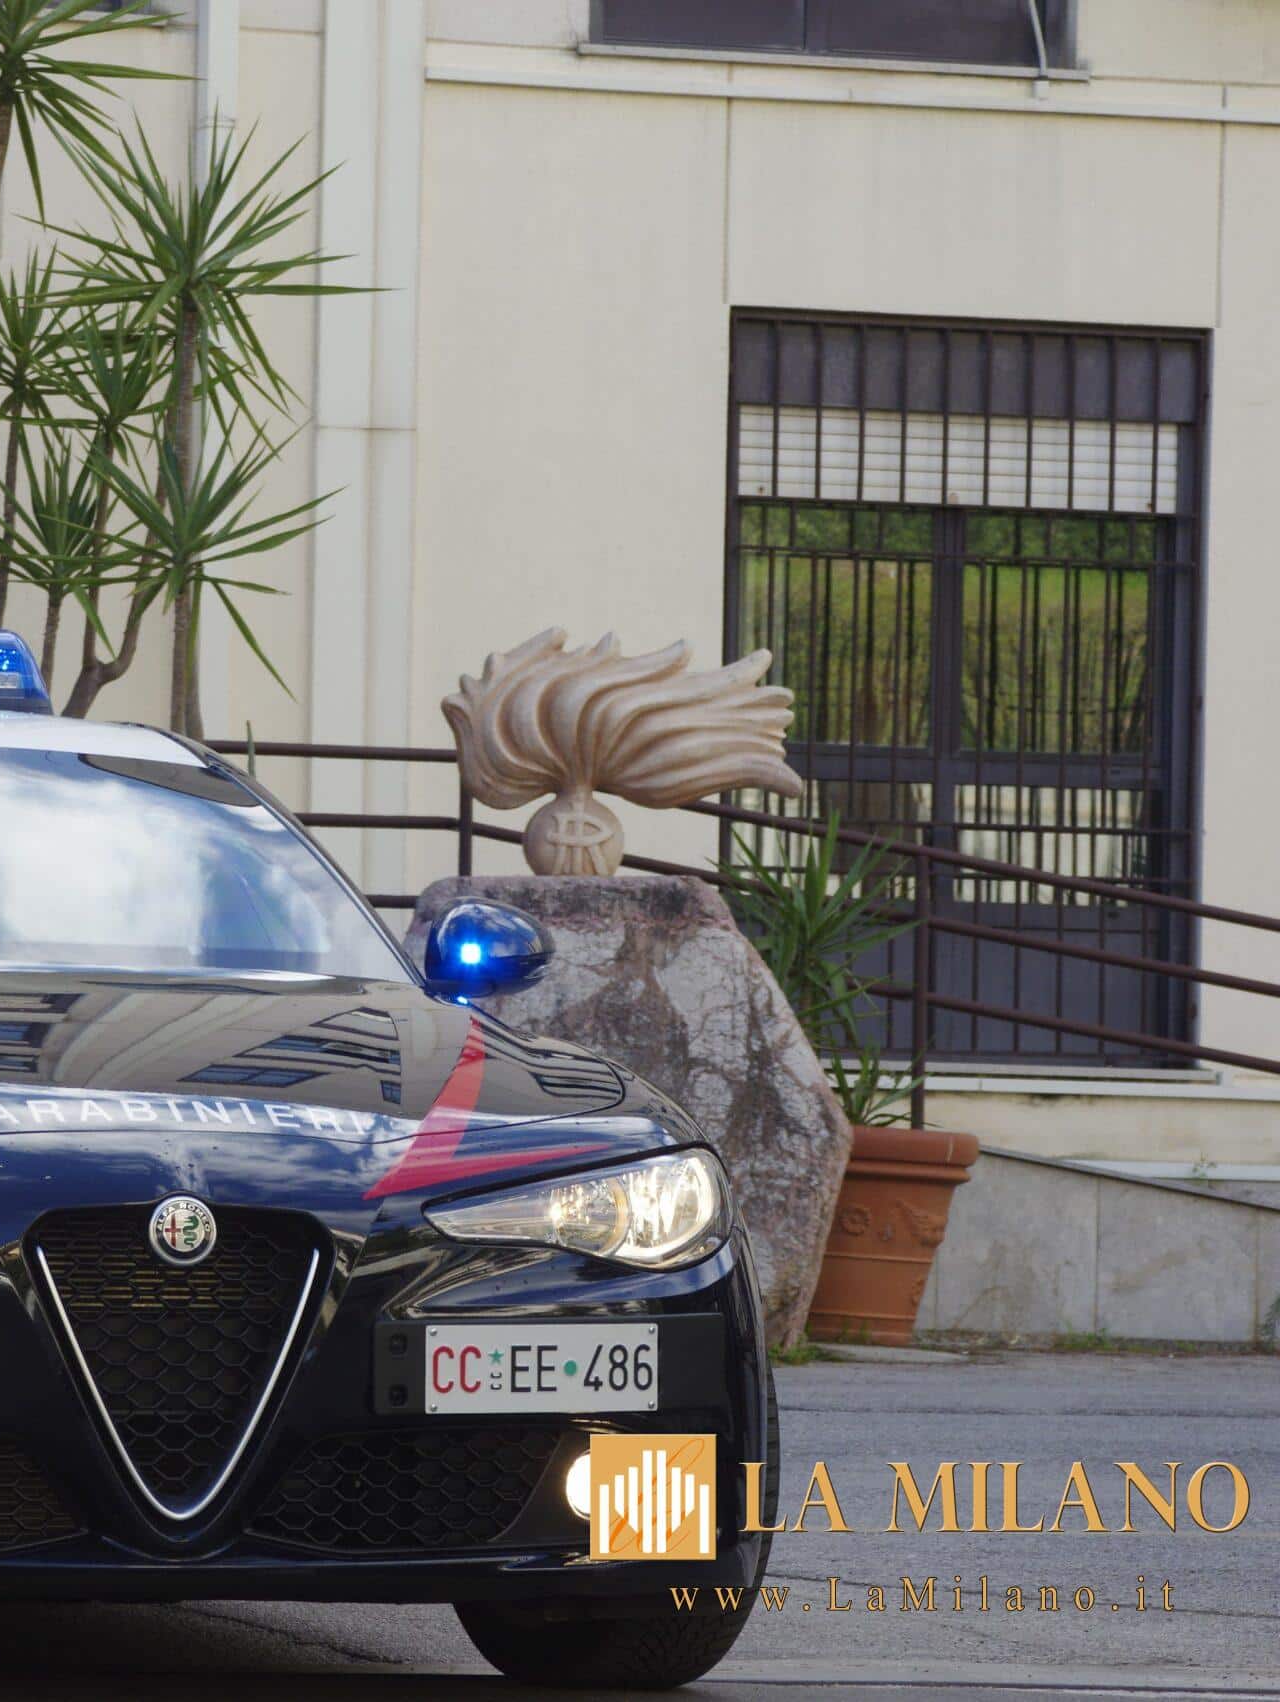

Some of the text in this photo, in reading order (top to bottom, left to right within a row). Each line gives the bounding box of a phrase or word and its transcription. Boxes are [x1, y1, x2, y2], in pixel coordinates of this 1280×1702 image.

[156, 1202, 211, 1232] ALFA ROMEO
[432, 1343, 653, 1393] CC EE 486
